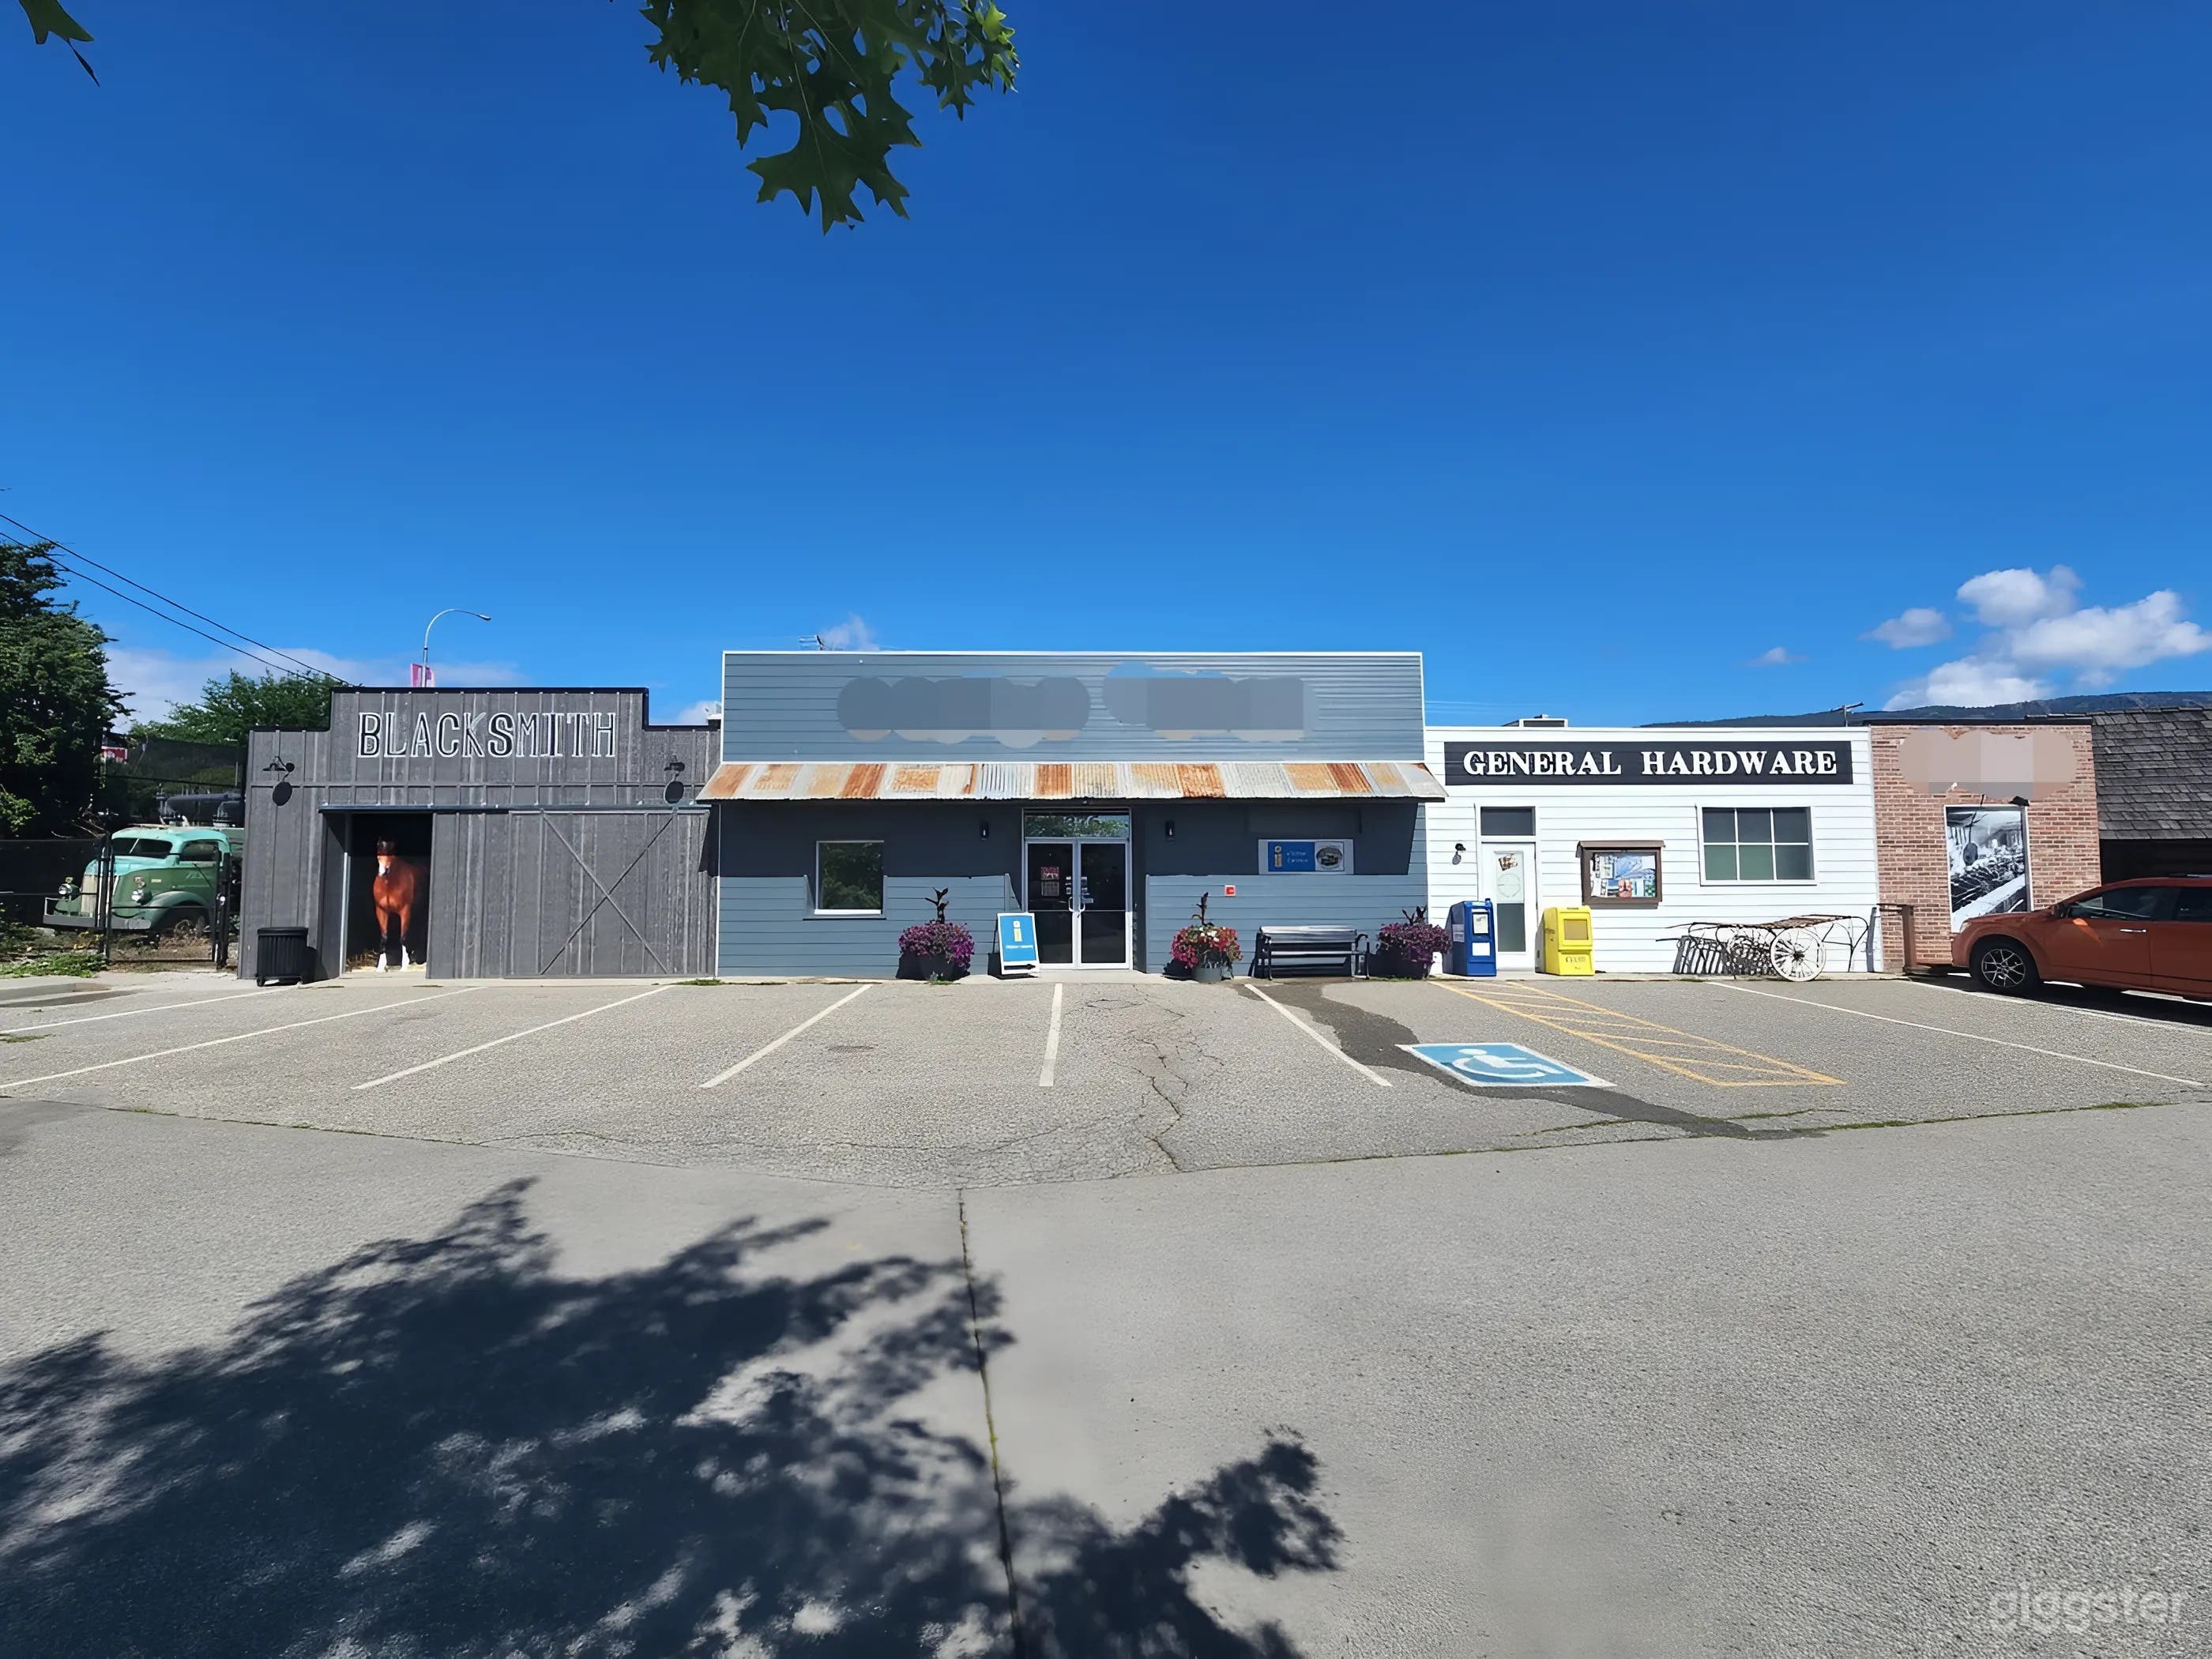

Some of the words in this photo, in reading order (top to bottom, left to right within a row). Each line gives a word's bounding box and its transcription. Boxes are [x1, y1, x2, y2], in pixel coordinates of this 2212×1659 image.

[357, 712, 616, 758] BLACKSMITH
[1463, 750, 1622, 776] GENERAL
[1641, 750, 1838, 776] HARDWARE
